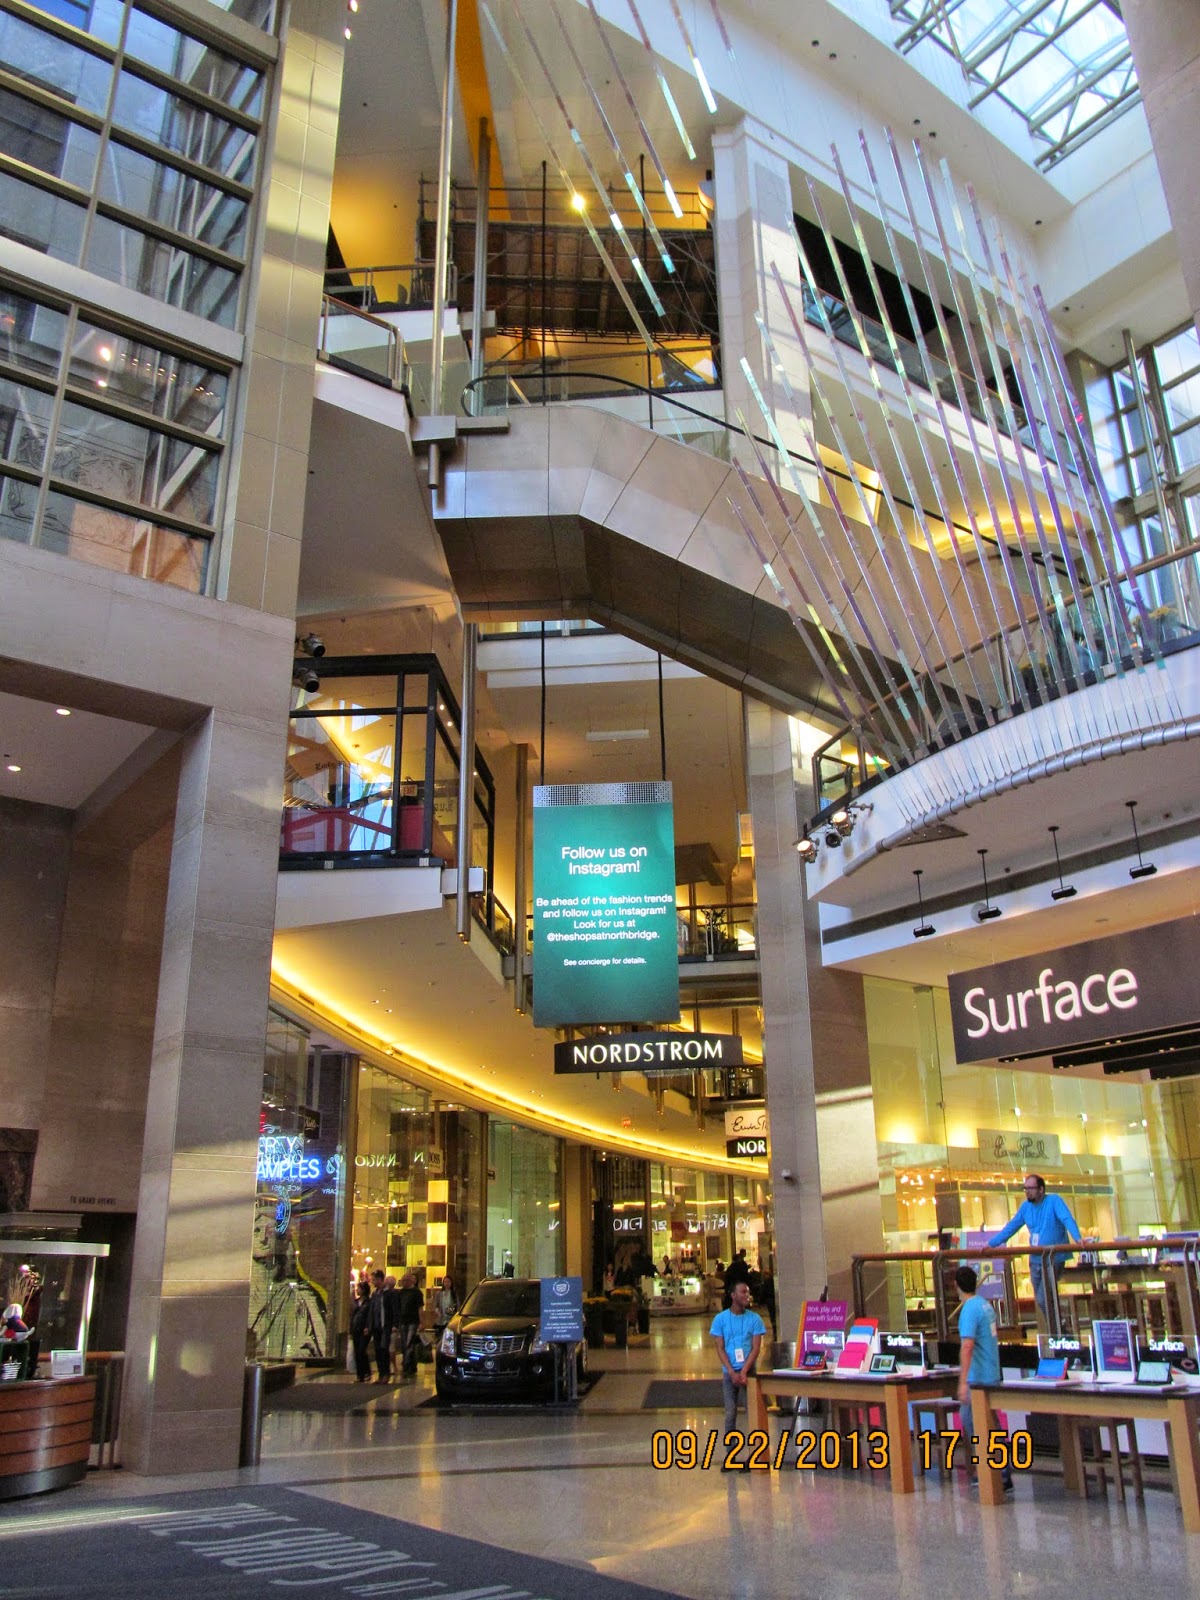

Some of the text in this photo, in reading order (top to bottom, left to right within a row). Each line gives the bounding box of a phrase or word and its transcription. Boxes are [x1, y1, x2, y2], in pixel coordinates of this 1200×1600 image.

[561, 846, 647, 859] Follow us on
[569, 860, 640, 877] Instagram!
[536, 894, 673, 907] Be ahead of the fashion trends
[543, 906, 667, 918] and follow us on Instagram!
[573, 919, 636, 929] Look for us at
[547, 930, 660, 942] @theshopsatnorthbridge.
[563, 956, 647, 967] See concierge for details.
[963, 968, 1139, 1039] Surface
[573, 1039, 723, 1066] NORDSTROM
[737, 1140, 766, 1154] NOR
[812, 1334, 836, 1345] Surface
[887, 1335, 913, 1346] Surface
[1048, 1337, 1080, 1350] Surface
[1149, 1339, 1185, 1351] Surface
